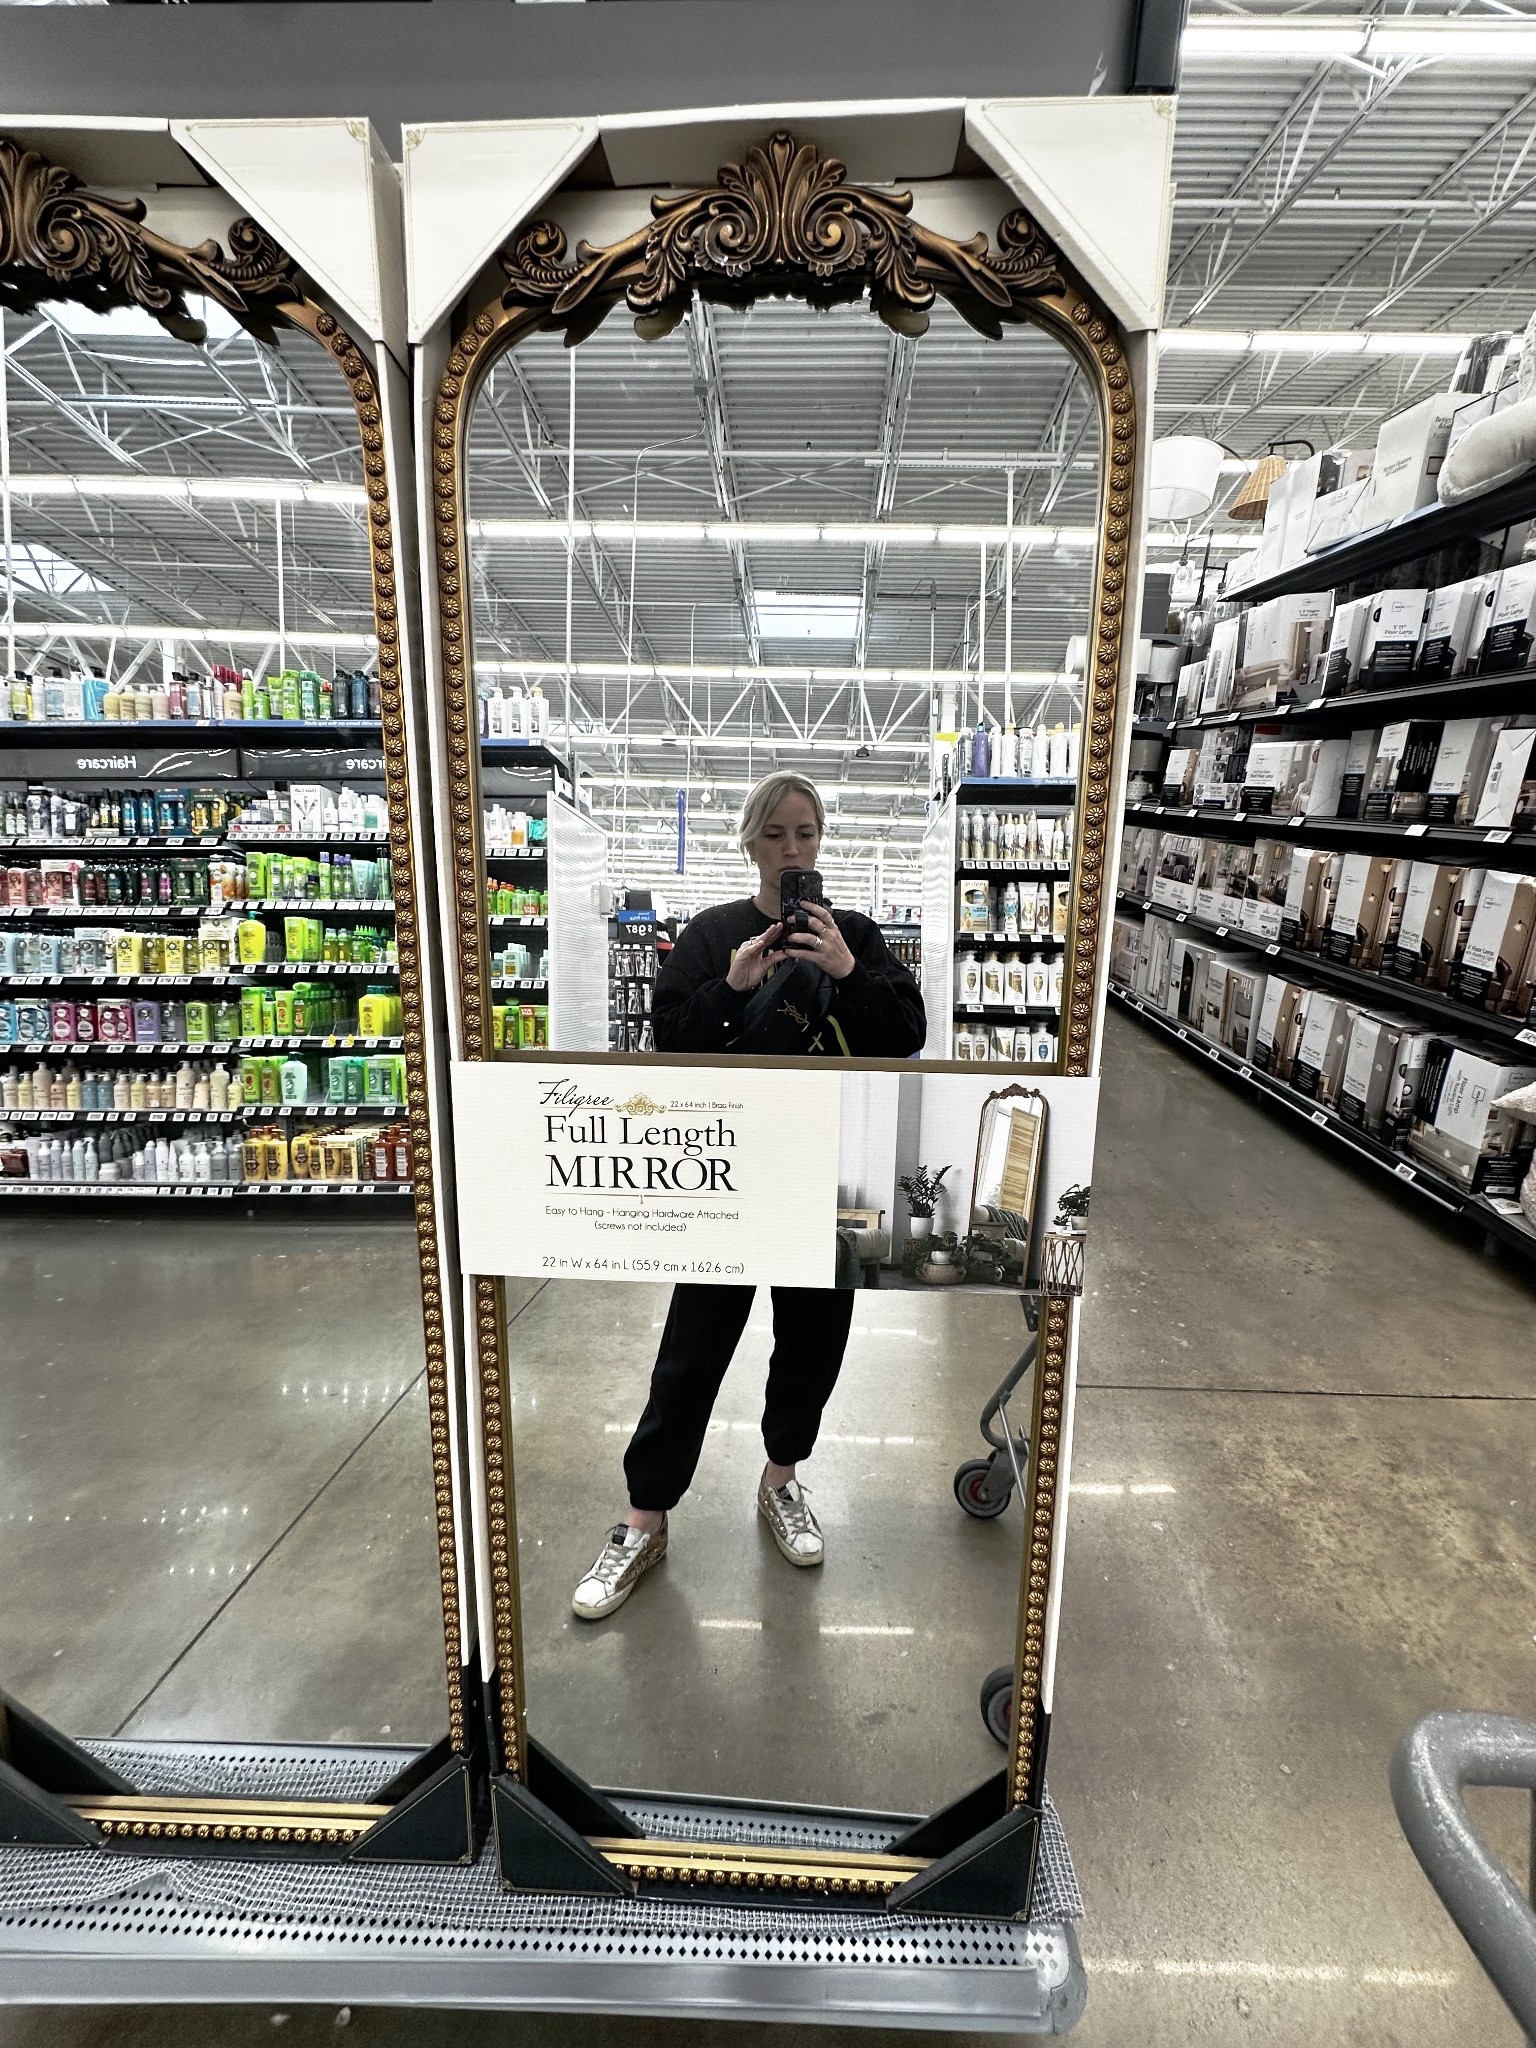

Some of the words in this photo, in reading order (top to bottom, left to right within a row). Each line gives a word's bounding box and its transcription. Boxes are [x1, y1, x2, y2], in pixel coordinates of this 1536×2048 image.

[1460, 1077, 1468, 1096] Floor
[538, 1079, 614, 1117] Filigree
[1453, 1095, 1464, 1114] Lamp
[544, 1115, 608, 1144] Full
[618, 1117, 737, 1156] Length
[545, 1154, 738, 1191] MIRROR
[545, 1206, 566, 1217] Easy
[568, 1207, 578, 1215] to
[580, 1206, 604, 1218] Hang
[612, 1207, 650, 1219] Hanging
[652, 1208, 694, 1219] Hardware
[696, 1210, 739, 1220] Attached
[594, 1221, 626, 1230] (screws
[627, 1222, 643, 1231] not
[644, 1222, 687, 1232] included)
[542, 1256, 556, 1268] 22
[559, 1258, 568, 1268] in
[571, 1258, 583, 1268] W
[593, 1259, 608, 1269] 64
[611, 1260, 621, 1269] in
[623, 1260, 629, 1269] L
[632, 1260, 660, 1271] (55.9
[663, 1263, 679, 1271] cm
[681, 1264, 687, 1272] x
[690, 1261, 721, 1273] 162.6
[725, 1263, 745, 1274] cm)
